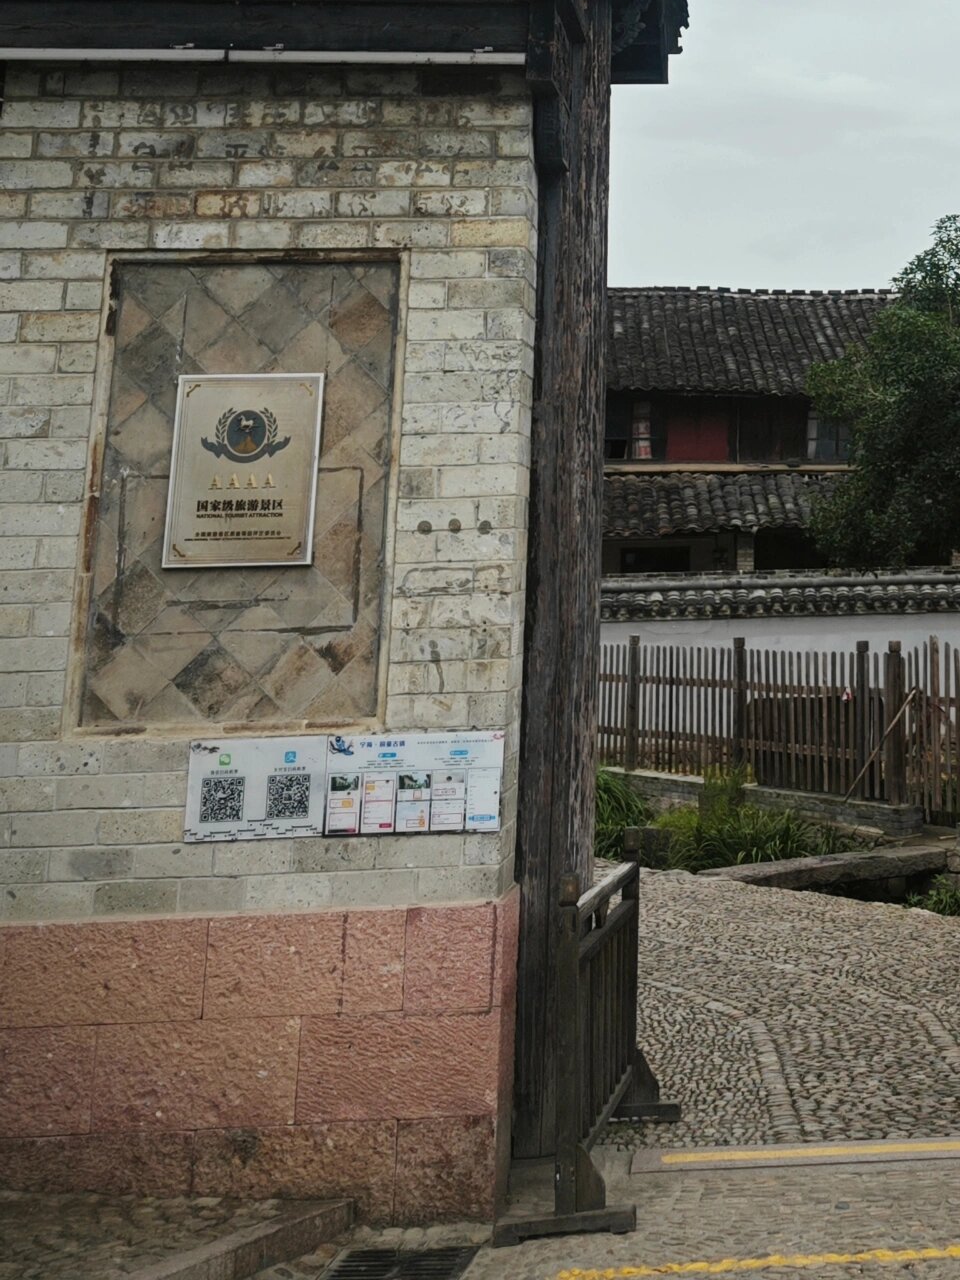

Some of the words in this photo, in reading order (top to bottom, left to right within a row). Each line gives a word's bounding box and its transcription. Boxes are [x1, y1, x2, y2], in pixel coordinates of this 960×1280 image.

[196, 499, 283, 512] 国家级旅游景区
